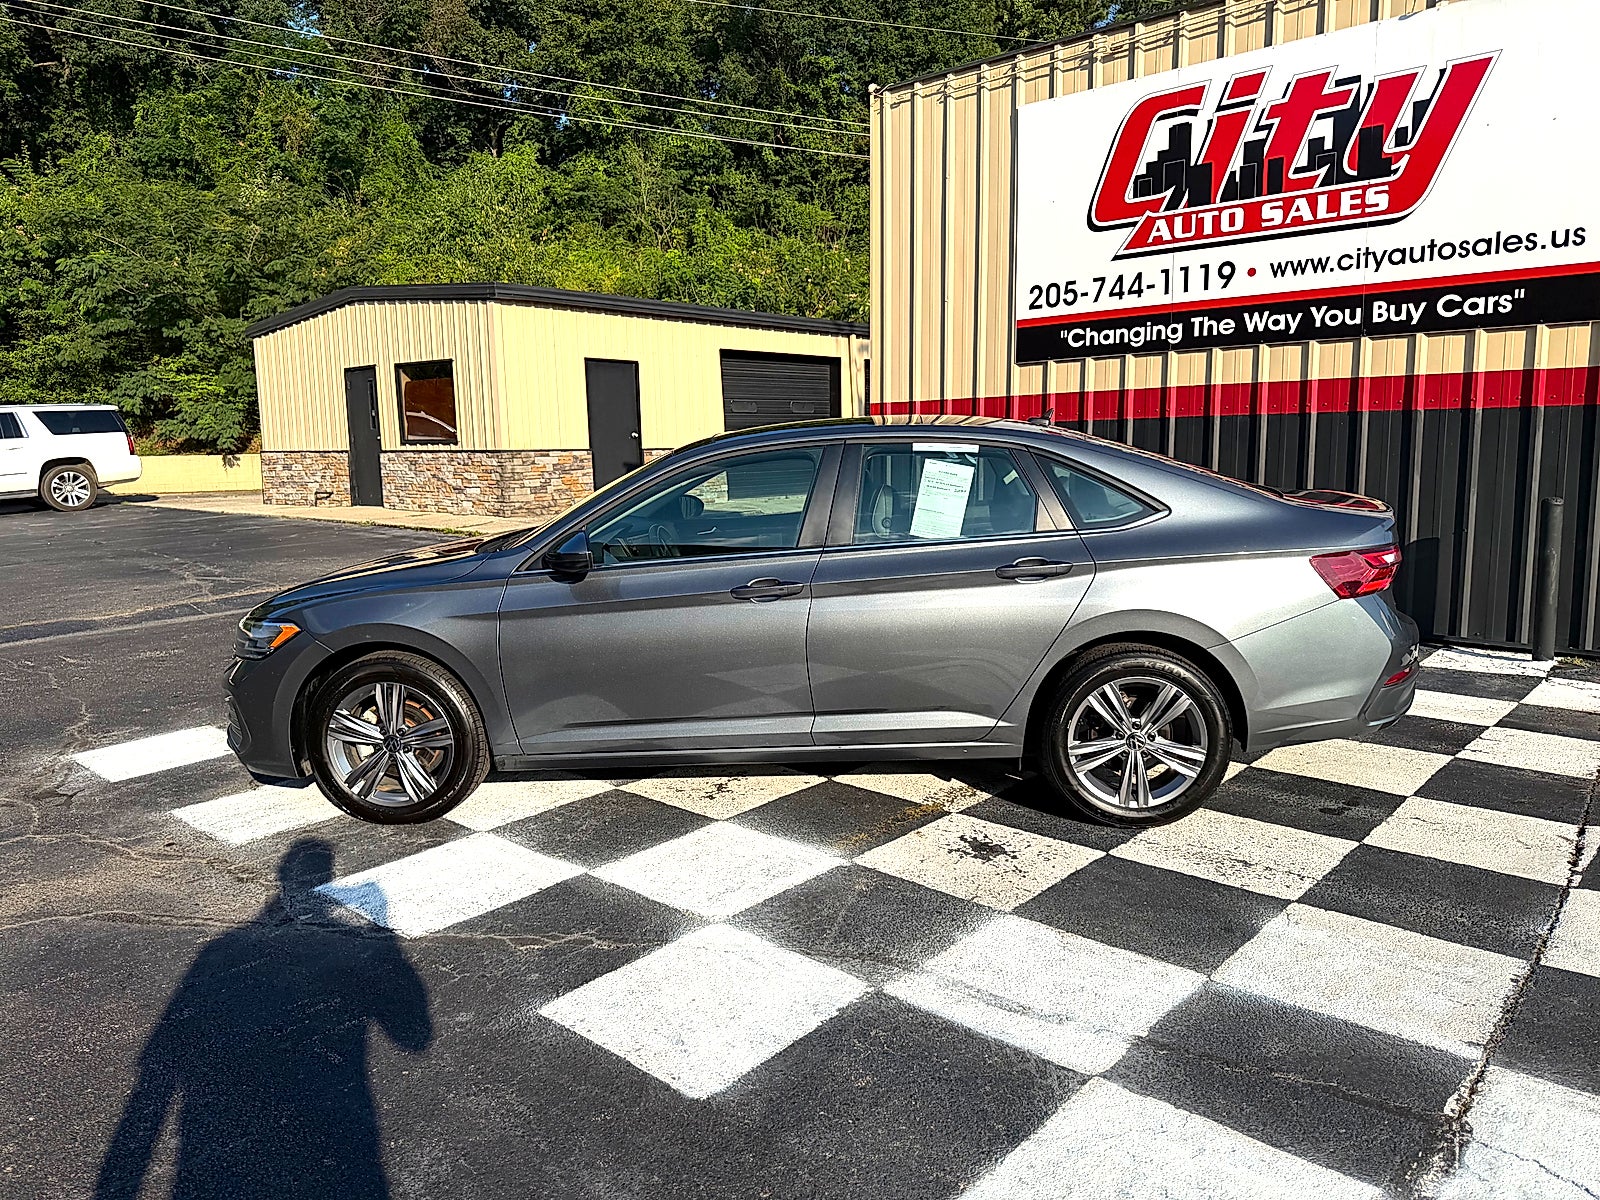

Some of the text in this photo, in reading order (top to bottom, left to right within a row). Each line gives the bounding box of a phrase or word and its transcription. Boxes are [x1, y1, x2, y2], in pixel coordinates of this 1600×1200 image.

[1094, 53, 1497, 224] City
[1146, 184, 1390, 243] AUTO SALES
[1028, 226, 1587, 310] 205-744-1119 www.cityautosales.us
[1060, 288, 1526, 348] "Changing The Way You Buy Cars"
